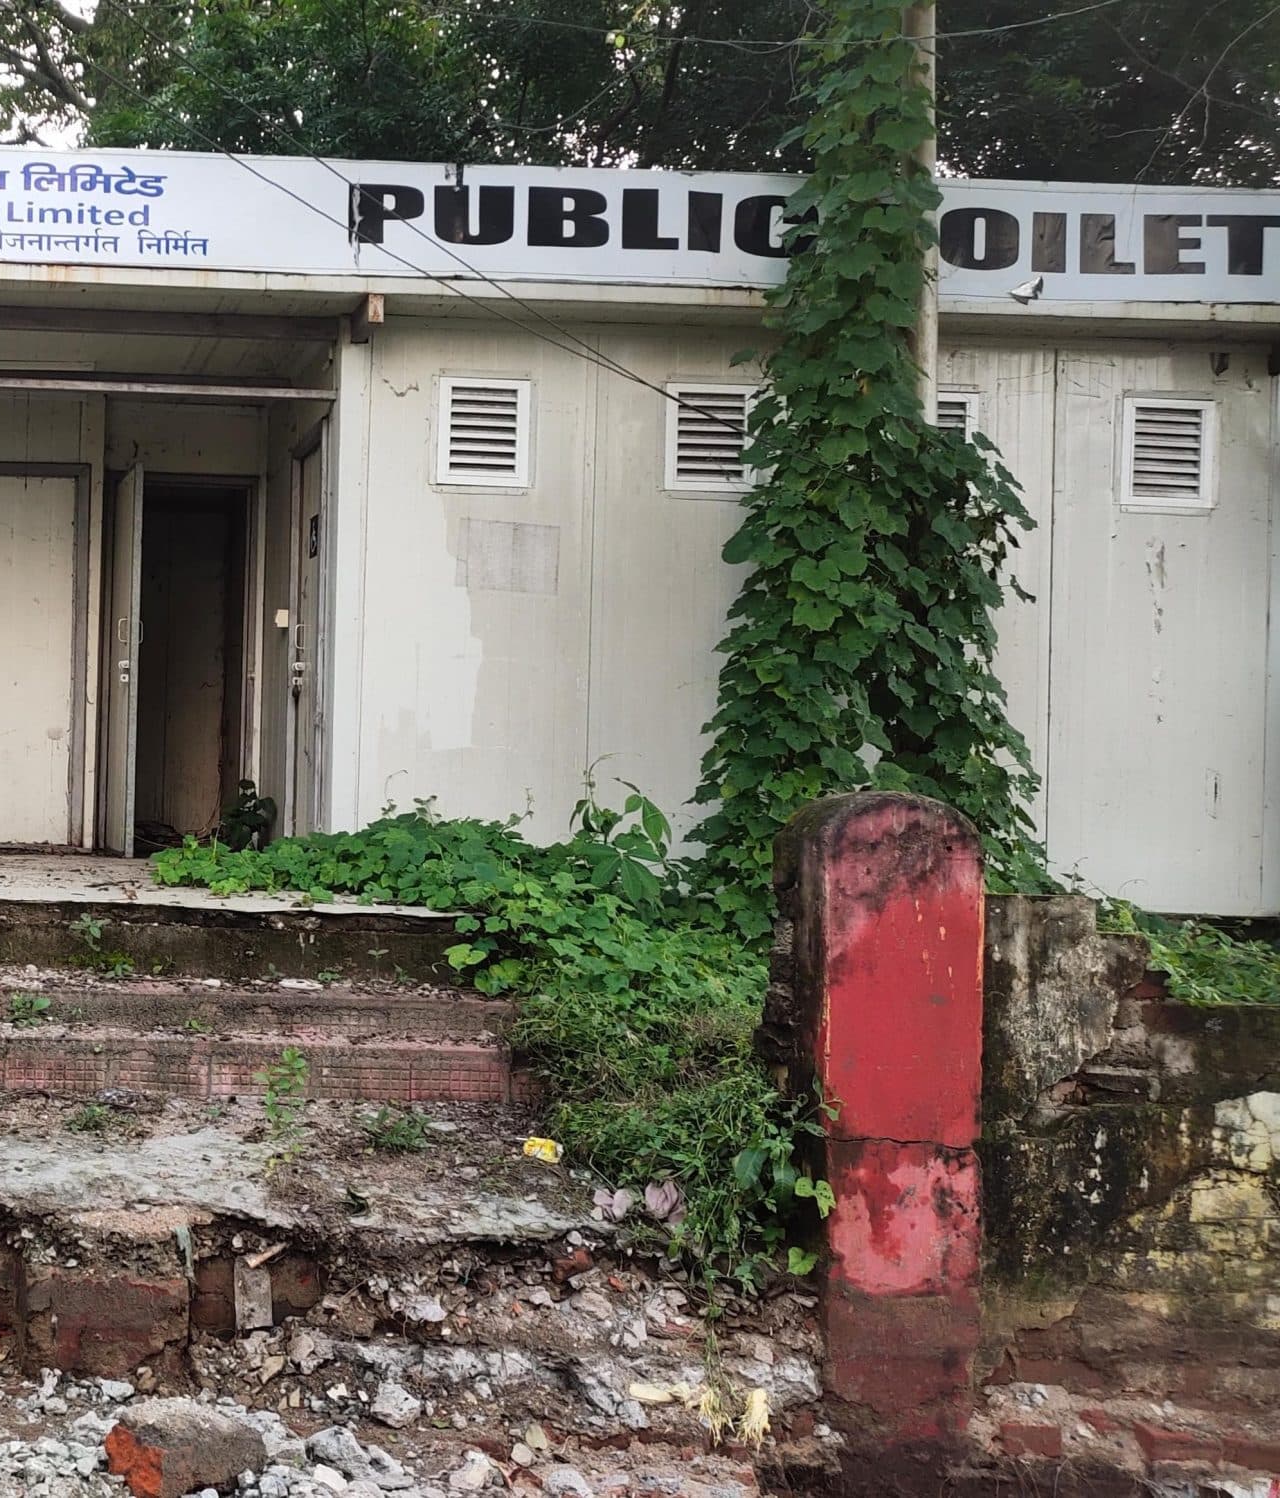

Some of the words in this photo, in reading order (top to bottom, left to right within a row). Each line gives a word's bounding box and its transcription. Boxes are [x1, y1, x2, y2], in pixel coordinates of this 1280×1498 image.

[20, 162, 168, 198] लिमिटेड
[7, 201, 150, 227] Limited
[137, 229, 209, 257] निर्मित
[939, 206, 1280, 276] OILET
